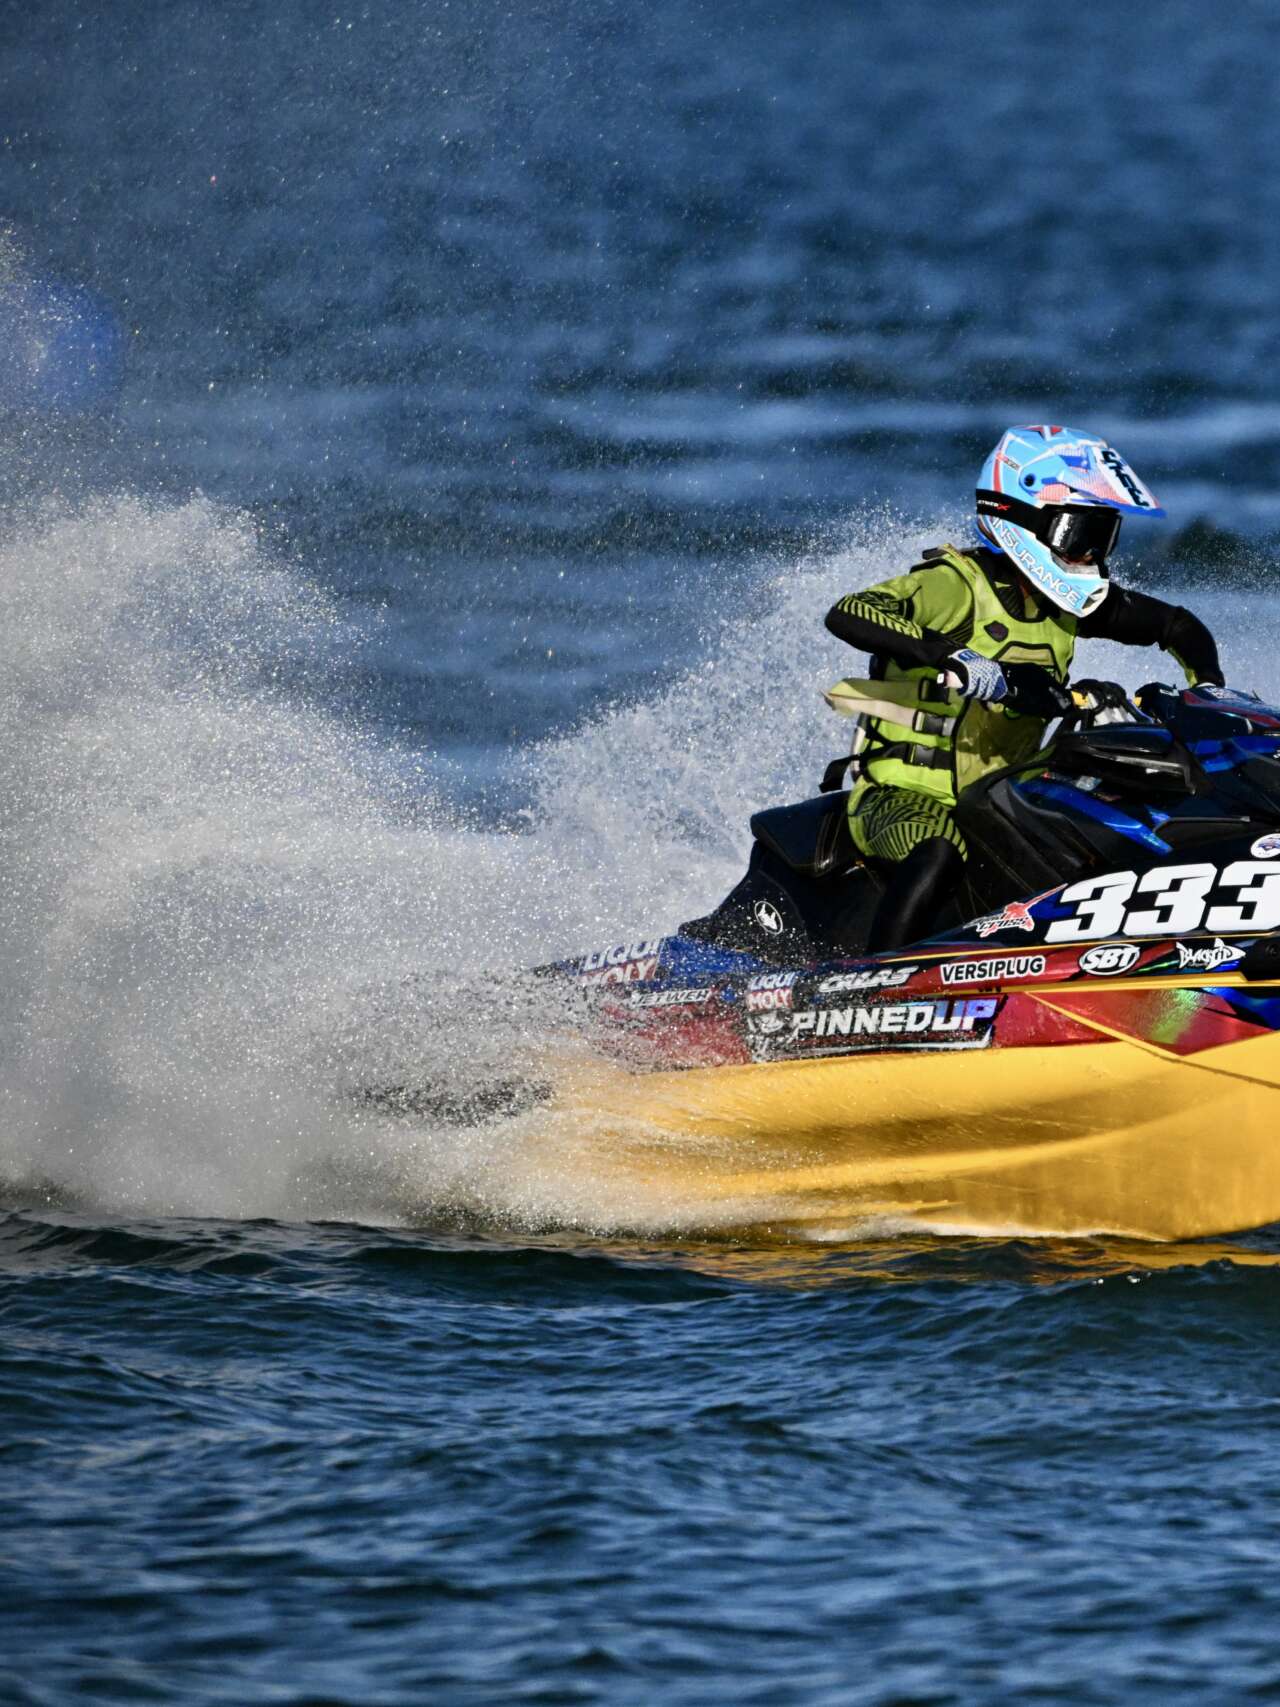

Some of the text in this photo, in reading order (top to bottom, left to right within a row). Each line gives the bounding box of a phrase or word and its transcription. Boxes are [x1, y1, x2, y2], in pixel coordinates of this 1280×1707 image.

[992, 516, 1078, 607] INSURANCE
[942, 957, 1043, 982] VERSIPLUG
[1083, 946, 1140, 970] SBT
[750, 972, 796, 991] LIQUI
[749, 989, 792, 1012] MOLY
[788, 999, 998, 1038] PINNEDUP
